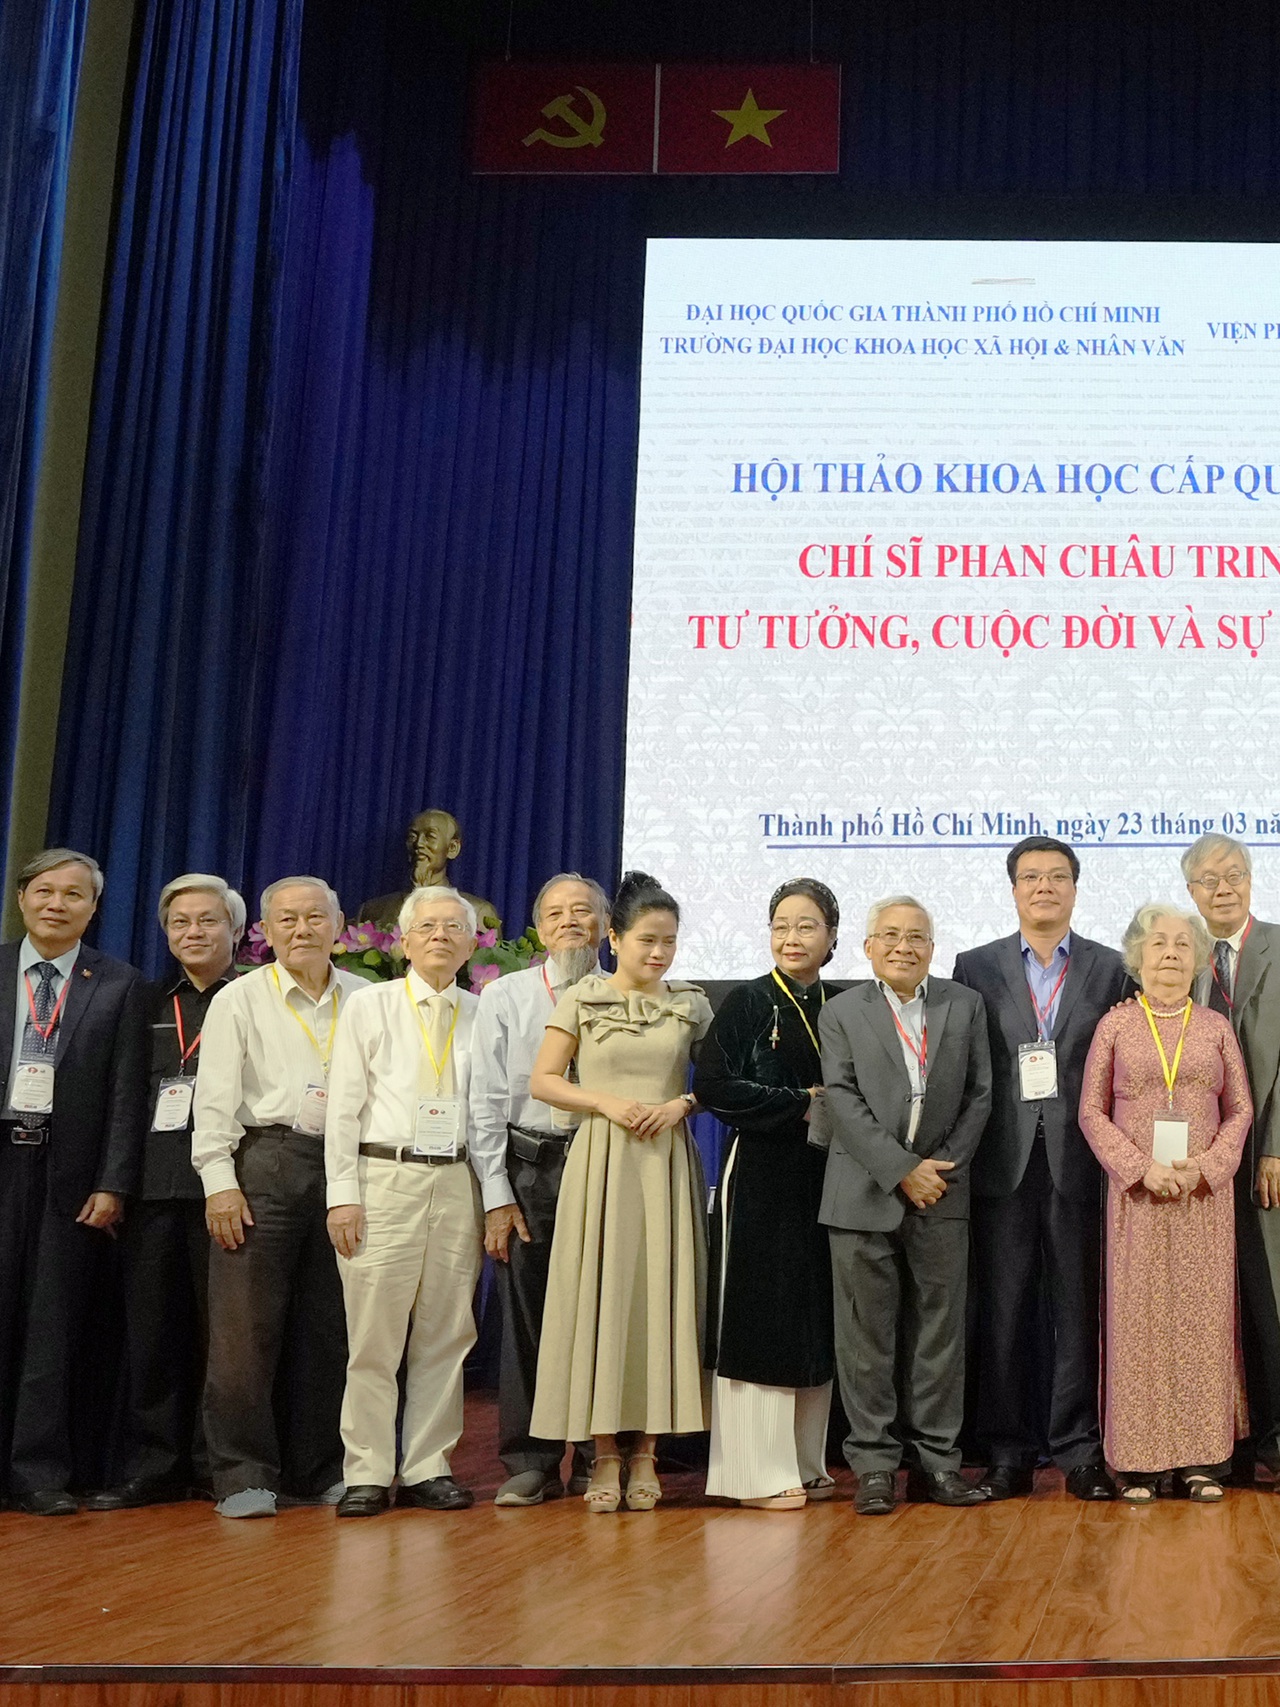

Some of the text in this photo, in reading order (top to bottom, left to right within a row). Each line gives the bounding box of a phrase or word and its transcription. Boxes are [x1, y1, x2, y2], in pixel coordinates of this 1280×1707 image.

[686, 299, 1161, 326] ĐẠI HỌC QUỐC GIA THÀNH PHỐ HỒ CHÍ MINH
[660, 332, 1187, 361] TRƯỜNG ĐẠI HỌC KHOA HỌC XÃ HỘI & NHÂN VĂN
[1206, 320, 1257, 345] VIỆN
[732, 457, 802, 502] HỘI
[813, 453, 923, 495] THẢO
[935, 462, 1048, 495] KHOA
[1057, 463, 1141, 503] HỌC
[1150, 453, 1227, 495] CẤP
[798, 533, 874, 580] CHÍ
[885, 535, 924, 580] SĨ
[935, 544, 1047, 579] PHAN
[1058, 533, 1176, 579] CHÂU
[687, 609, 752, 650] TƯ
[758, 604, 920, 656] TƯỞNG,
[931, 608, 1052, 659] CUỘC
[1062, 602, 1137, 650] ĐỜI
[1149, 604, 1207, 649] VÀ
[1217, 609, 1274, 659] SỰ
[758, 812, 833, 837] Thành
[841, 806, 884, 843] phố
[892, 806, 925, 837] Hồ
[932, 812, 974, 837] Chí
[980, 811, 1049, 838] Minh,
[1056, 812, 1111, 842] ngày
[1117, 811, 1143, 836] 23
[1150, 811, 1215, 835] tháng
[1221, 811, 1247, 835] 03
